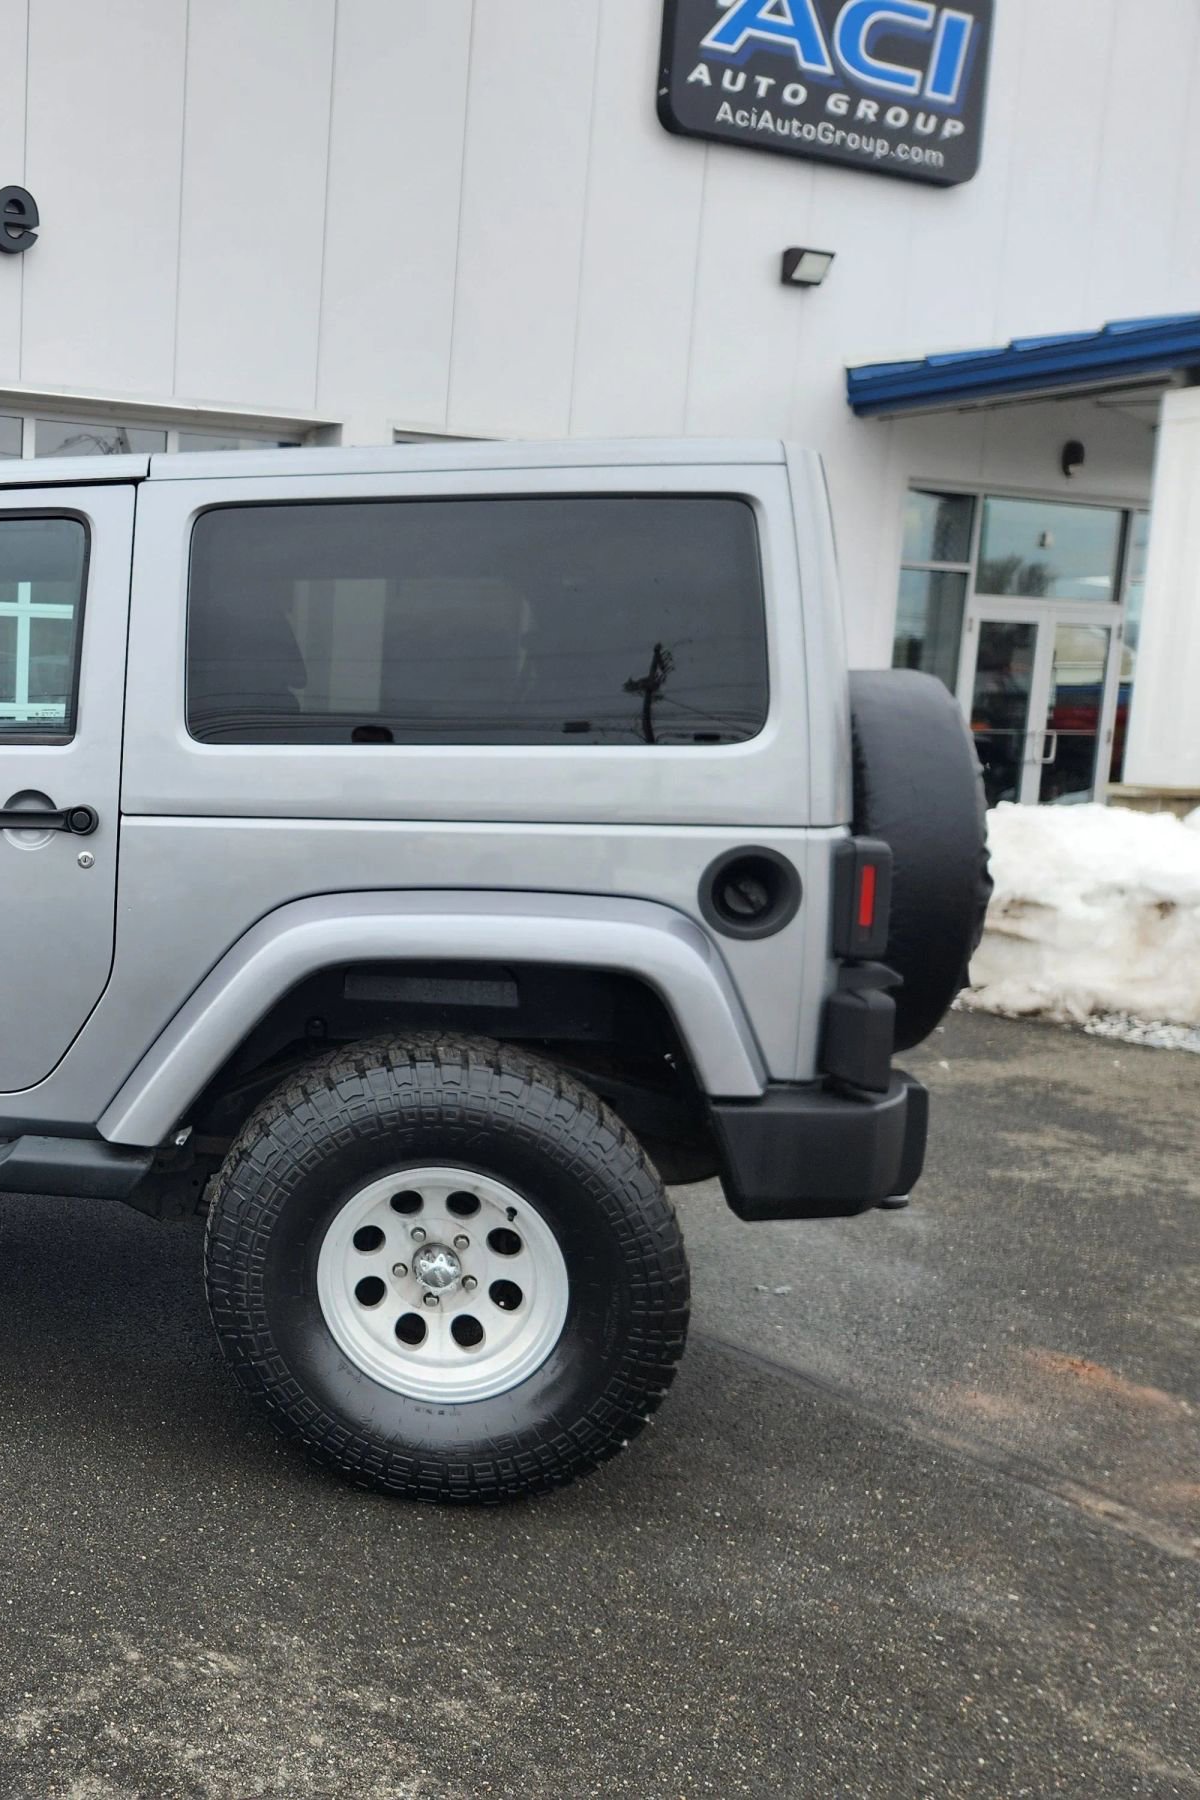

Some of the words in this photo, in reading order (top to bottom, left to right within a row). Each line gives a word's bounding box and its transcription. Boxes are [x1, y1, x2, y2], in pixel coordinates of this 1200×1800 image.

[700, 0, 973, 104] ACI
[687, 62, 809, 107] AUTO
[825, 91, 966, 141] GROUP
[715, 100, 945, 168] AciAutoGroup.com
